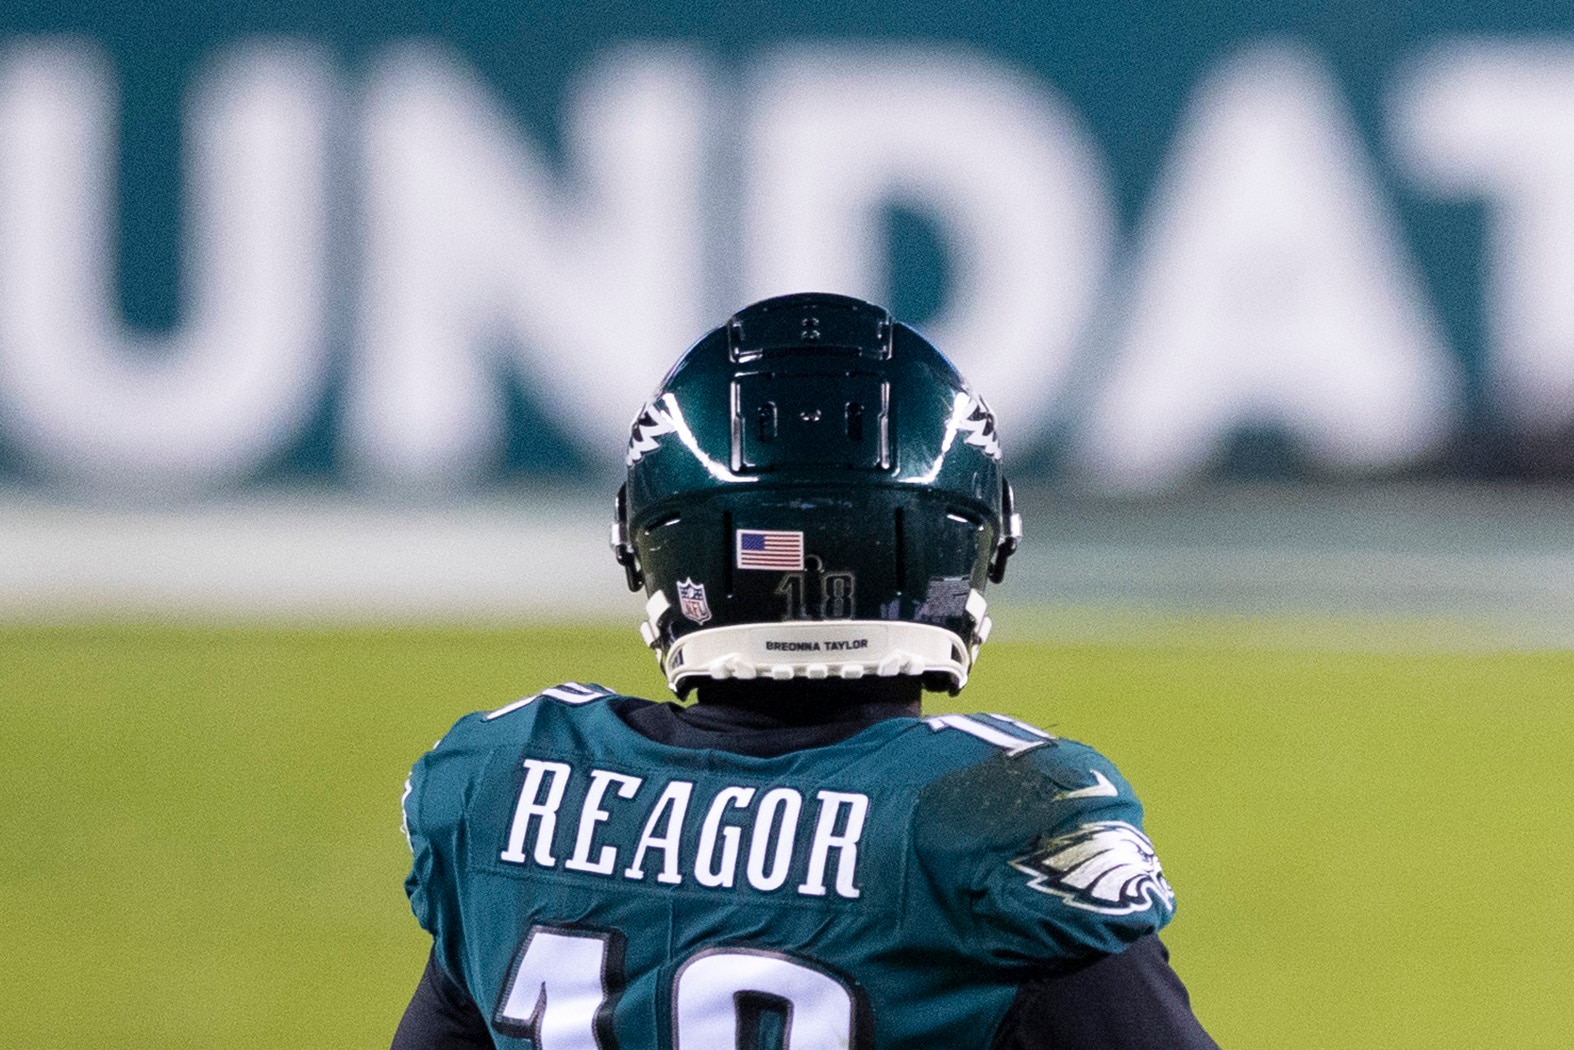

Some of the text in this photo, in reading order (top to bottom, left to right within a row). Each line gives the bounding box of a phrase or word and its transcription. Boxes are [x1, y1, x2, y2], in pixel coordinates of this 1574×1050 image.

[774, 571, 855, 620] 18
[765, 638, 869, 651] BREONNA TAYLOR
[500, 757, 870, 898] REAGOR
